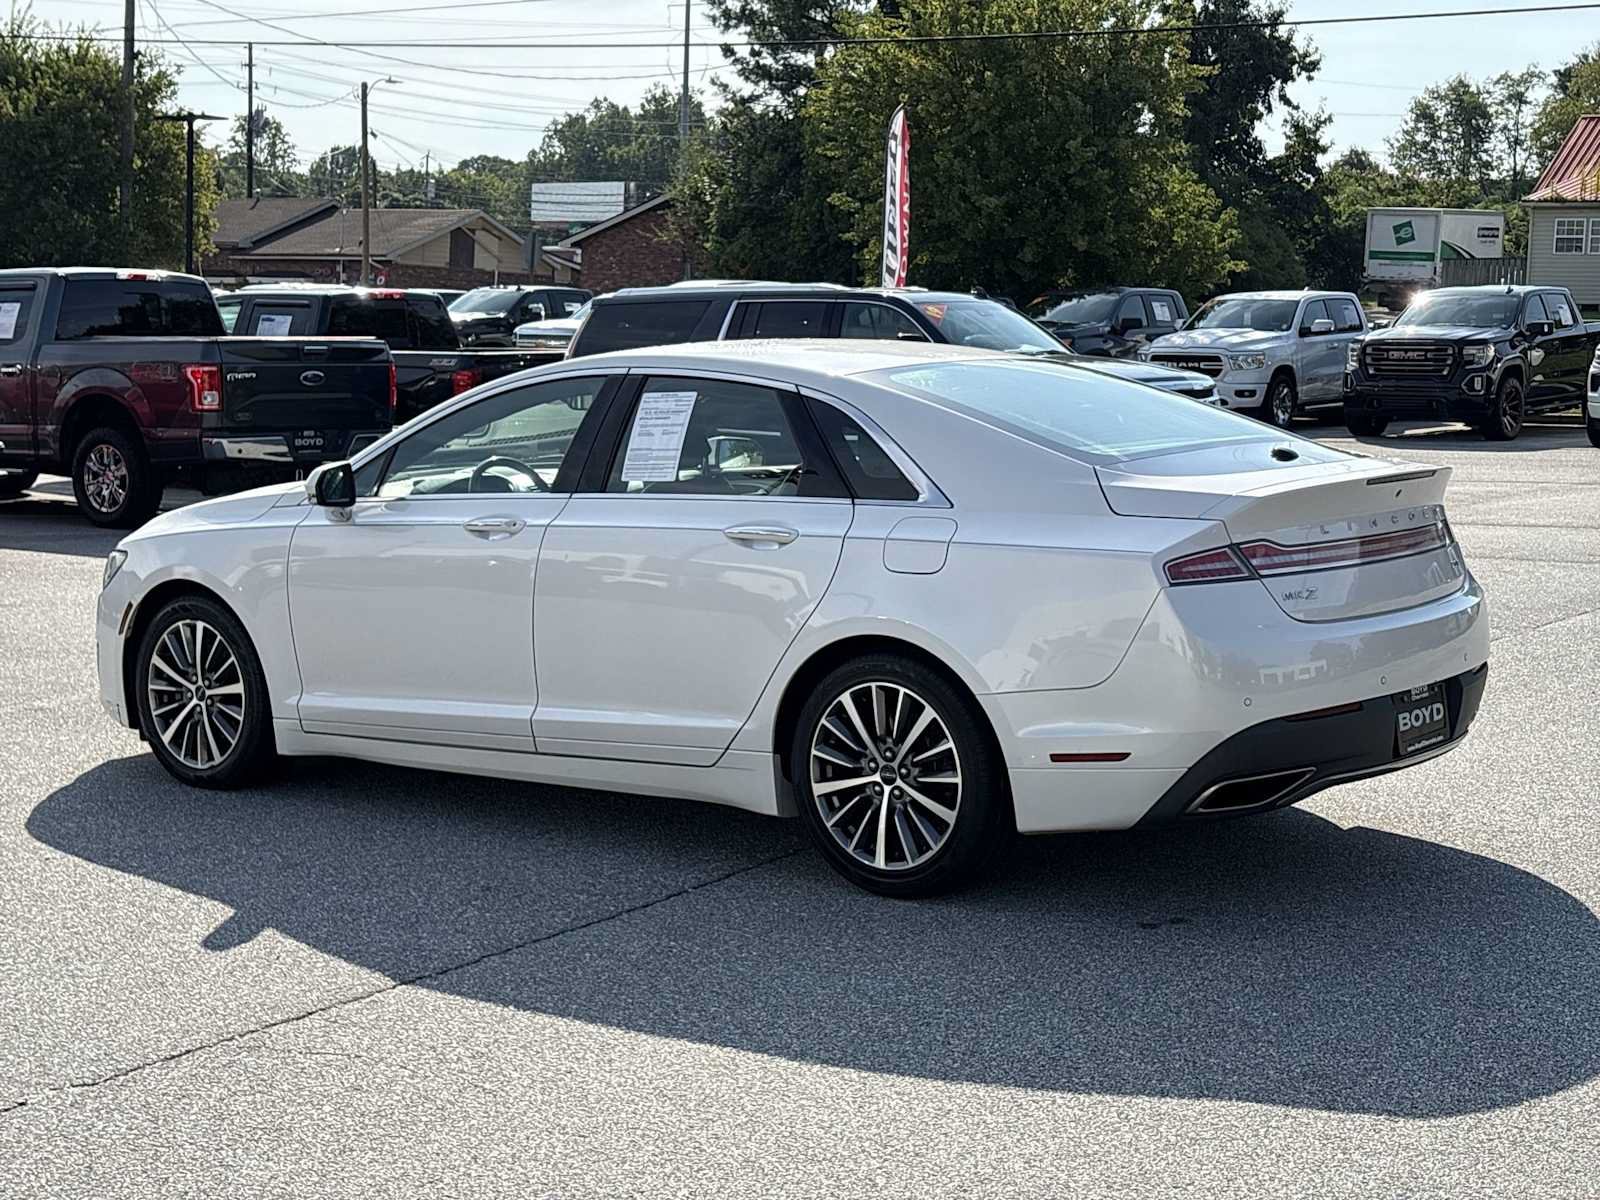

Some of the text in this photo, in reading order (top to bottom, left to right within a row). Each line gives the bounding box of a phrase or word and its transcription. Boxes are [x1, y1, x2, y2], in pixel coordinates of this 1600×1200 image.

[1388, 351, 1426, 360] GMC
[1167, 361, 1200, 369] RAM
[294, 438, 324, 447] BOYD
[1398, 702, 1445, 732] BOYD
